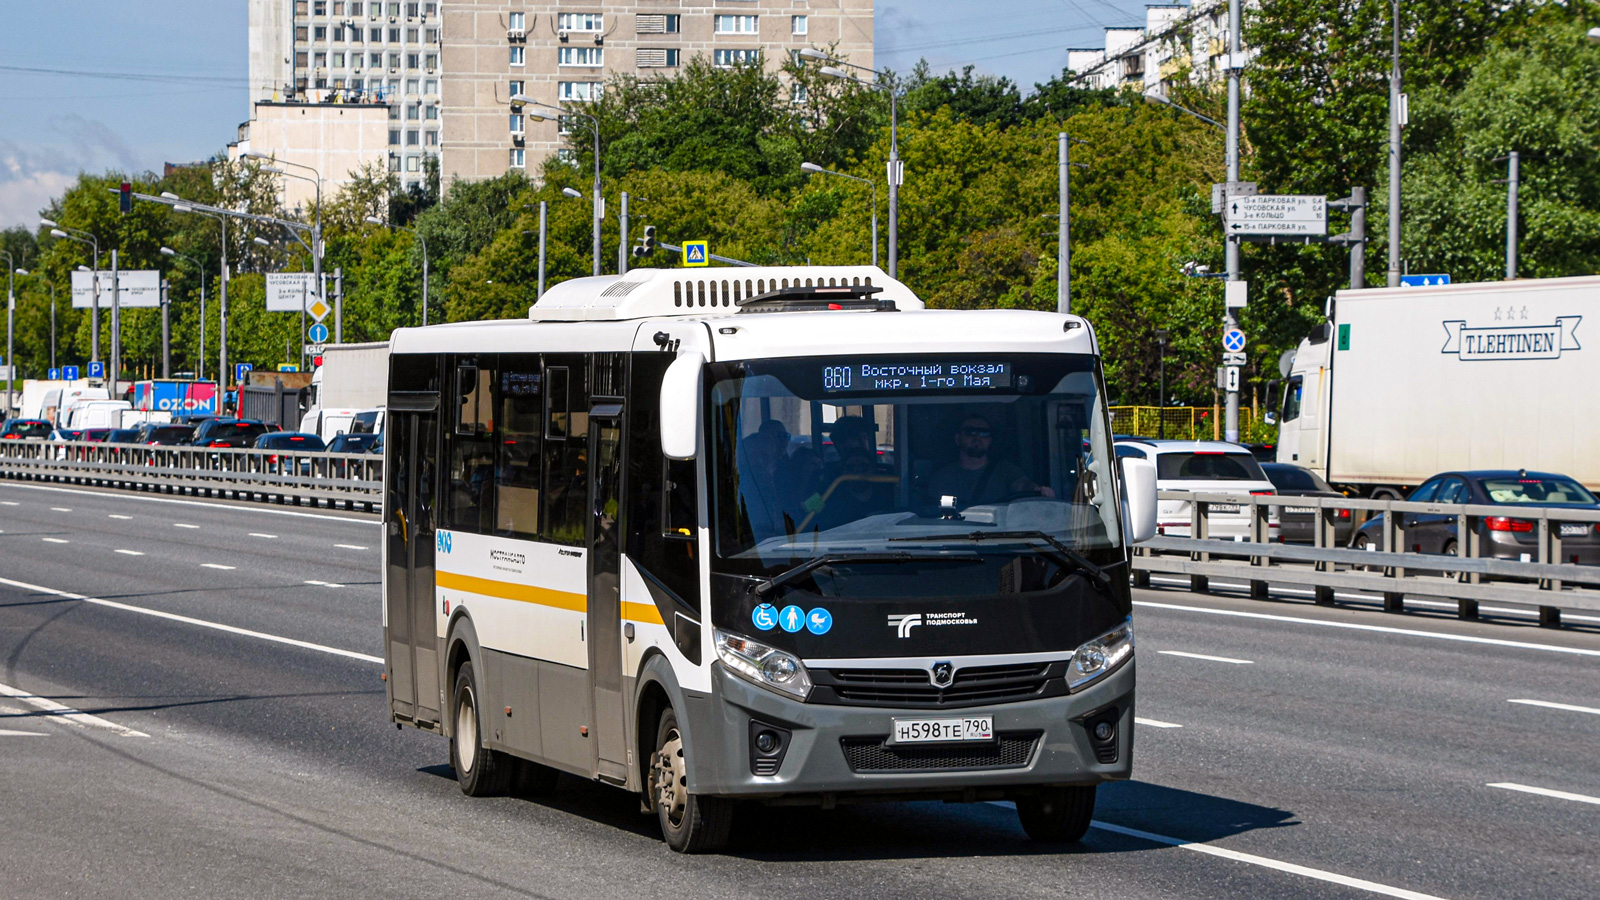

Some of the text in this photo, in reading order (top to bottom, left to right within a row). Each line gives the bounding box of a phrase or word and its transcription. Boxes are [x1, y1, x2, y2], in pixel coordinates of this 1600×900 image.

[1465, 333, 1555, 354] T.LEHTINEN
[824, 366, 852, 388] 860
[862, 363, 1004, 377] Восточный вокзал
[875, 374, 991, 389] мкр. 1-го Мая
[159, 398, 210, 411] OZON
[926, 618, 978, 626] ПОДМОСКОВЬЯ
[965, 719, 988, 733] 790
